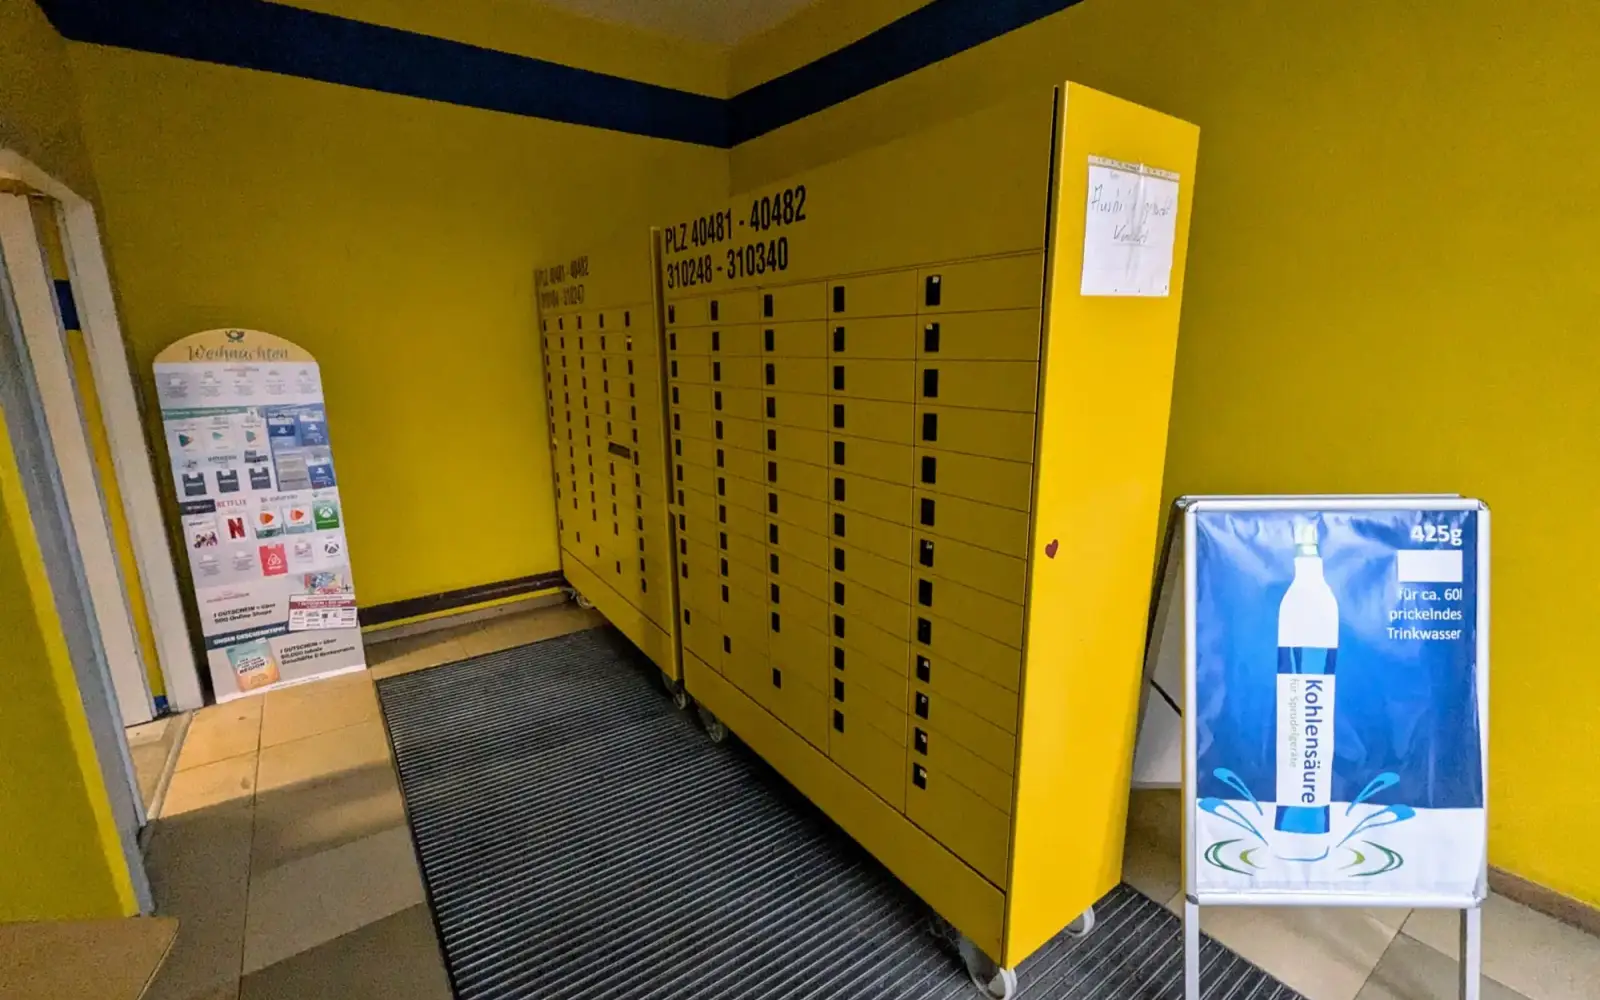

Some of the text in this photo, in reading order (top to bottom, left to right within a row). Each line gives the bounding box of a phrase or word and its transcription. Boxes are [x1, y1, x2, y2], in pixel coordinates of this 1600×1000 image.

[664, 222, 688, 255] PLZ
[691, 207, 732, 248] 40481
[749, 184, 806, 232] 40482
[666, 253, 713, 289] 310248
[726, 236, 788, 280] 310340
[188, 344, 289, 361] Weihnachten
[1411, 524, 1463, 546] 425g
[1397, 588, 1417, 601] für
[1421, 590, 1441, 601] ca.
[217, 606, 255, 618] GUTSCHEIN
[1389, 606, 1462, 623] prickelndes
[1386, 626, 1462, 640] Trinkwasser
[1288, 698, 1301, 769] Sprudelgeräte
[1301, 679, 1324, 804] Kohlensäure
